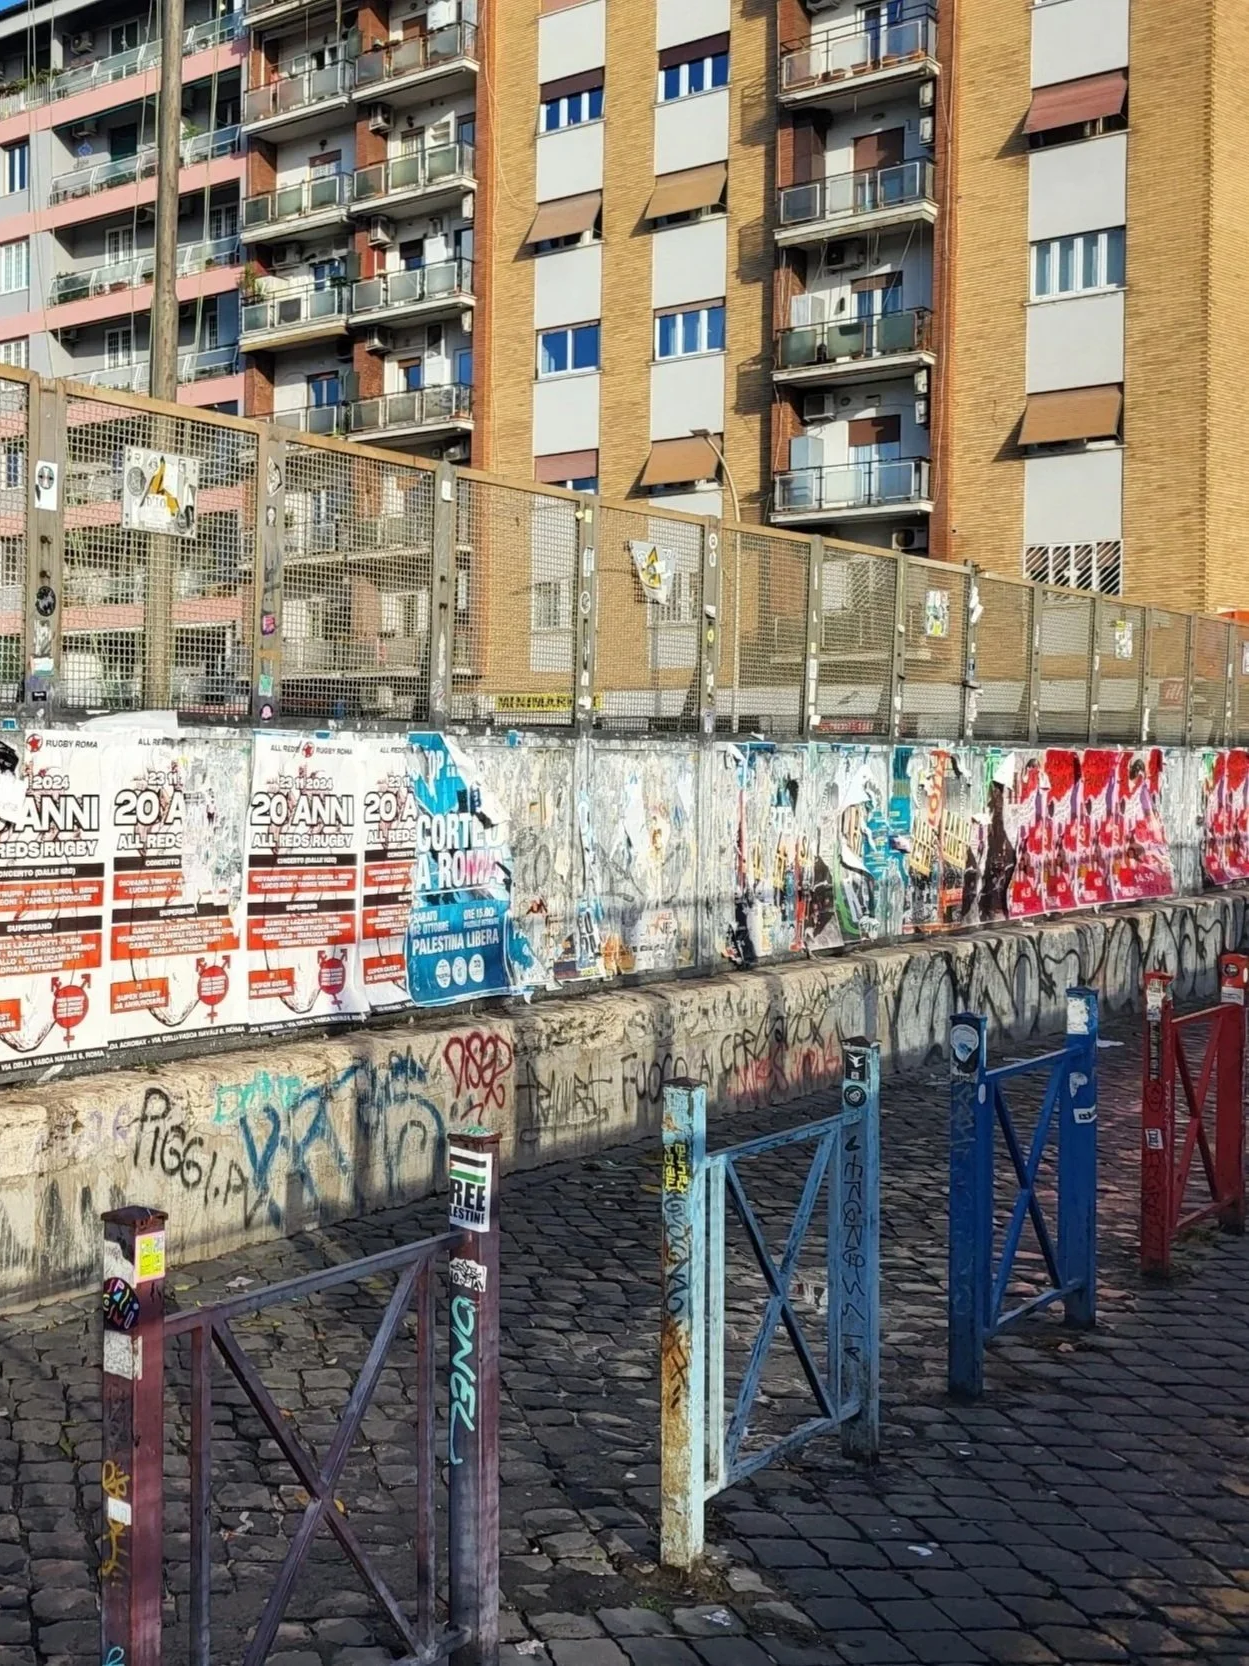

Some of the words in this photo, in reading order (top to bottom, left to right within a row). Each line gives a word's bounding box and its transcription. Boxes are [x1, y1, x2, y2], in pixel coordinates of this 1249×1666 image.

[32, 775, 70, 790] 2024
[148, 771, 165, 786] 23
[279, 775, 293, 789] 23
[295, 777, 305, 789] 11
[307, 777, 333, 791] 2024
[13, 794, 100, 832] ANNI
[114, 789, 160, 826] 20
[250, 792, 288, 826] 20
[291, 794, 354, 826] ANNI
[364, 792, 397, 823] 20
[117, 833, 144, 850] ALL
[252, 833, 276, 848] ALL
[279, 833, 310, 847] REDS
[311, 833, 353, 848] RUGBY
[367, 829, 386, 843] ALL
[43, 839, 99, 857] RUGBY
[416, 853, 432, 891] A
[438, 850, 503, 890] ROMA
[412, 932, 465, 956] PALESTINA
[467, 928, 499, 948] LIBERA
[450, 1178, 486, 1212] REE
